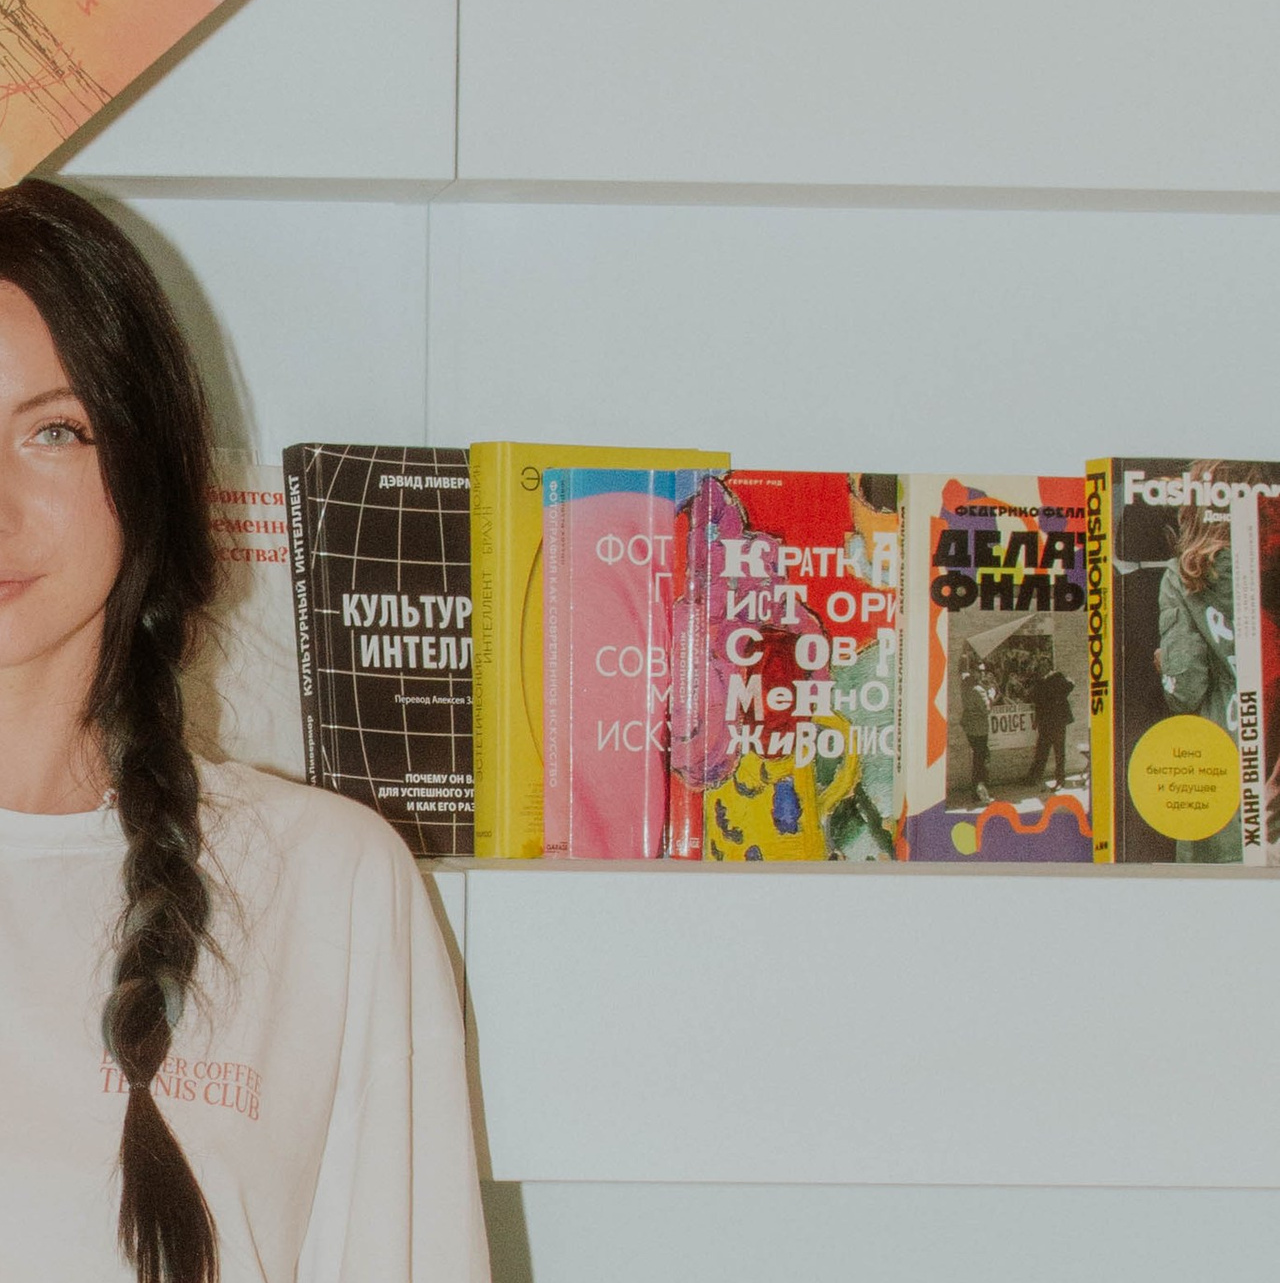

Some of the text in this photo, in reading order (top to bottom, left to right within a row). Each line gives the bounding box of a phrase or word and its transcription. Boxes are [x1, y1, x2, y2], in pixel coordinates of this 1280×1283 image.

[378, 474, 423, 489] ДЭВИД
[954, 504, 1039, 519] ФЕДЕРИКО
[286, 474, 313, 697] КУЛЬТУРНЫЙ ИНТЕЛЛЕКТ
[1086, 470, 1109, 717] Fashionopolis
[341, 592, 472, 629] КУЛЬТУР
[548, 479, 559, 788] ФОТОГРАФИЯ КАК СОВРЕМЕННОЕ ИСКУССТВО
[595, 645, 668, 678] СОВ
[394, 694, 431, 706] Перевод
[431, 695, 465, 705] Алексея
[991, 713, 1026, 734] DOLCE
[1172, 747, 1202, 760] Цена
[1146, 764, 1228, 777] быстрой моды
[1239, 690, 1261, 847] ЖАНР ВНЕ СЕБЯ
[405, 773, 465, 785] ПОЧЕМУ ОН
[377, 787, 462, 799] ДЛЯ УСПЕШНОГО
[1157, 782, 1217, 795] и будущее
[406, 801, 457, 812] И КАК ЕГО
[1166, 801, 1210, 812] одежды
[193, 1060, 263, 1096] COFFEE
[203, 1081, 261, 1122] CLUB
